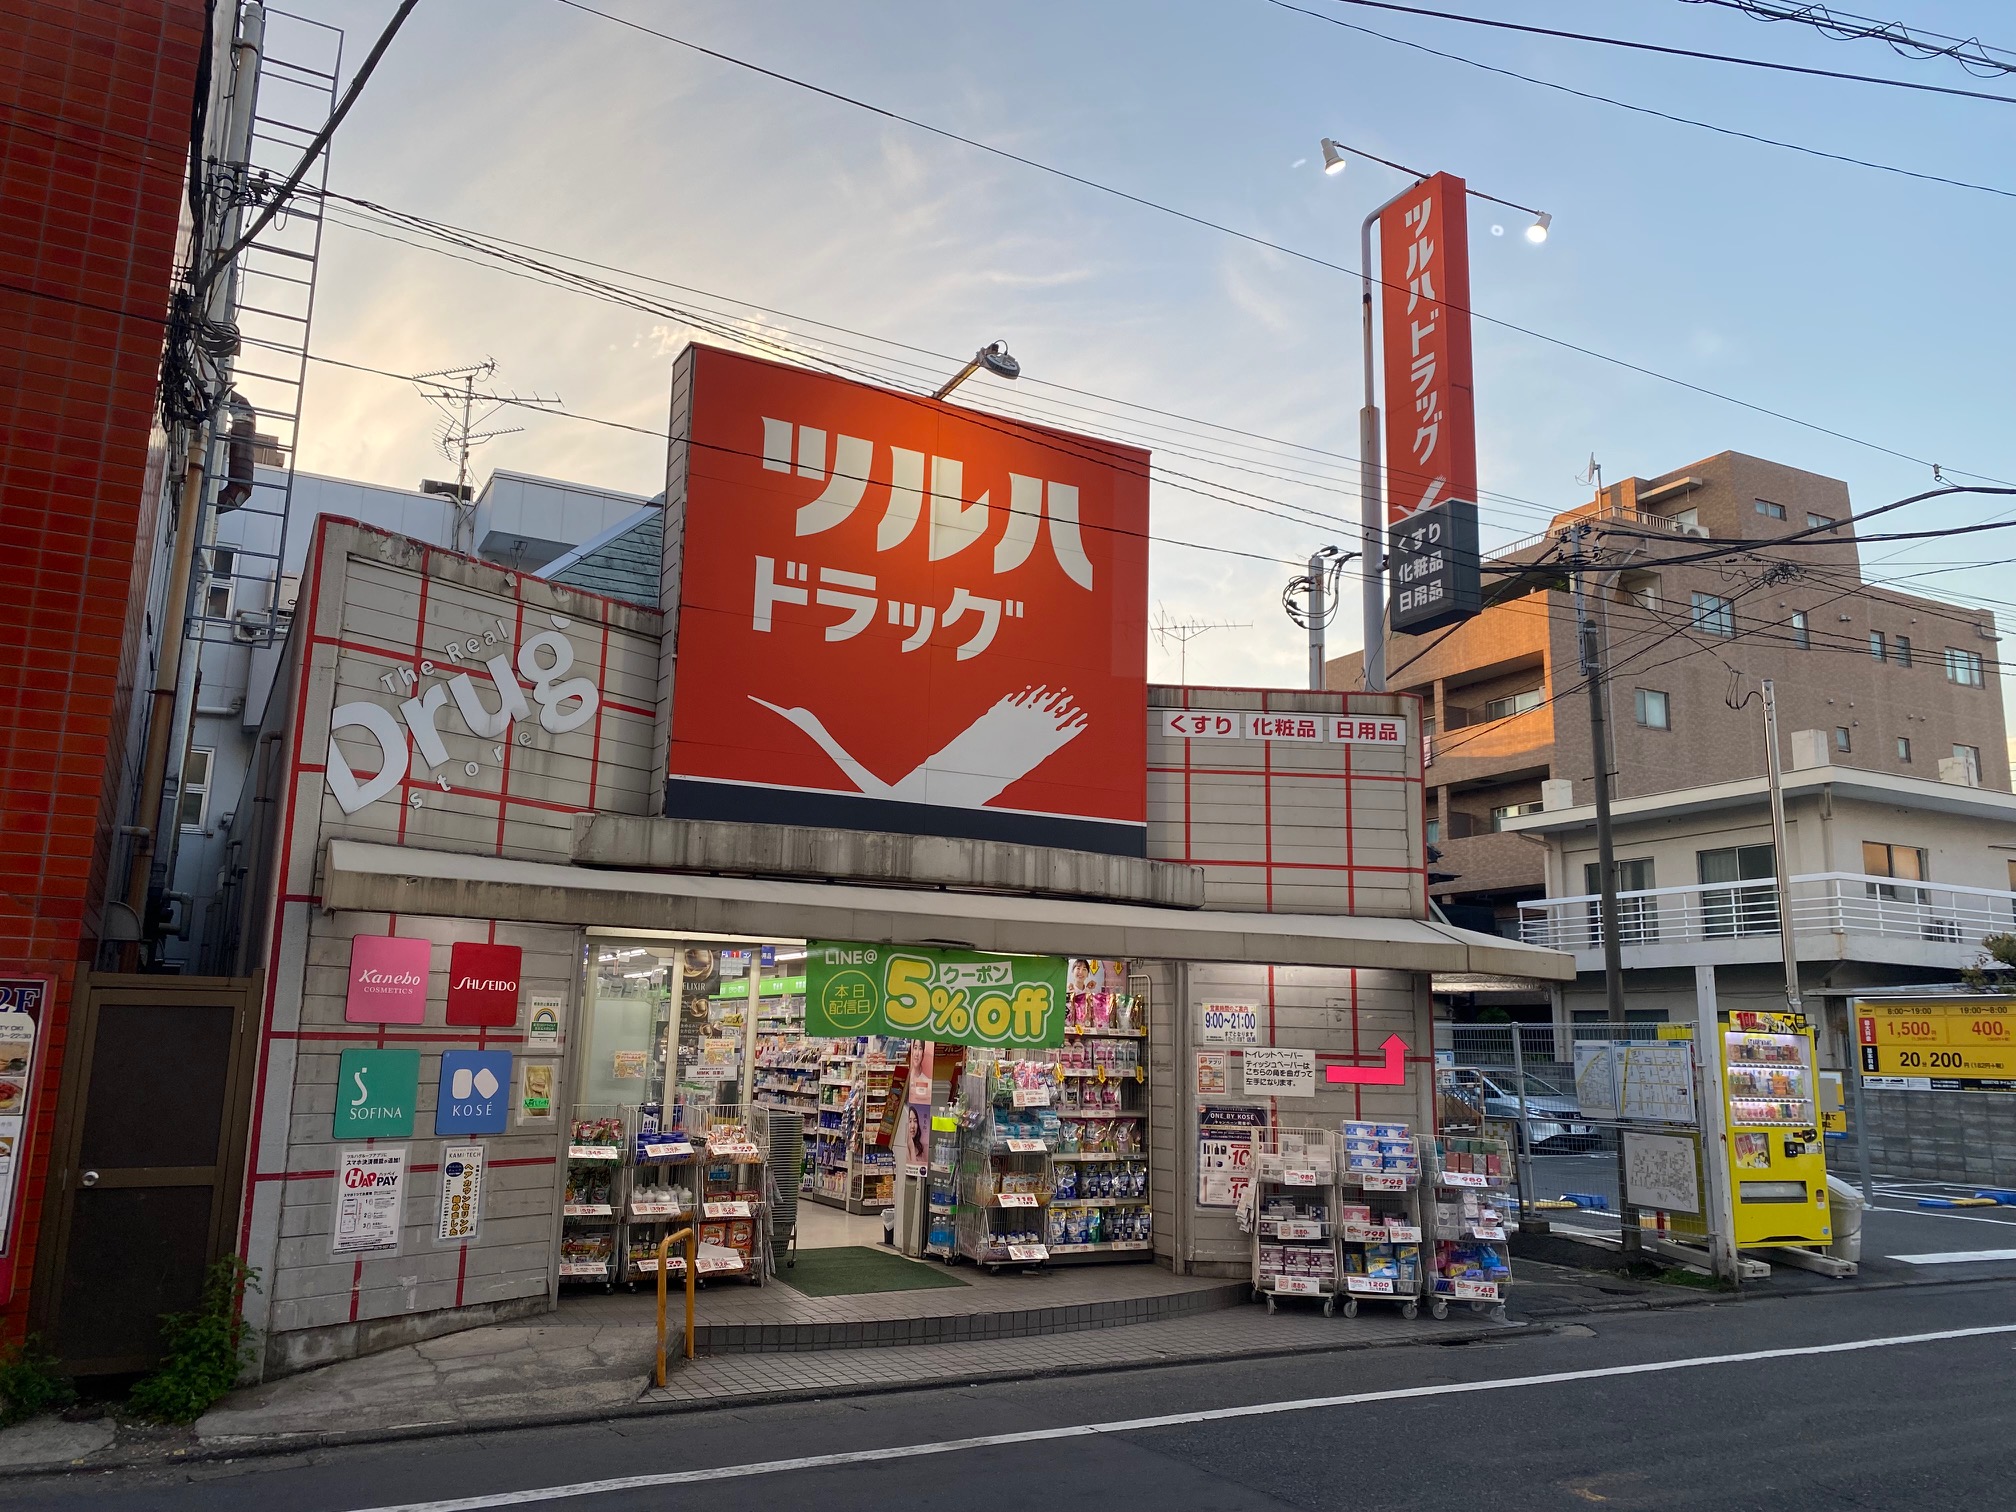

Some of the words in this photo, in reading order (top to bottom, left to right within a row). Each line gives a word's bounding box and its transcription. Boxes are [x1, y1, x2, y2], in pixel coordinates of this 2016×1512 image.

[1404, 197, 1443, 466] ツルハドラッグ
[761, 416, 1094, 592] ツルハ
[1397, 522, 1441, 554] くすり
[1398, 550, 1444, 584] 化粧品
[1399, 579, 1444, 612] 日用品
[752, 555, 1024, 662] ドラッグ
[379, 660, 435, 694] The
[444, 619, 509, 664] Real
[325, 614, 600, 816] Drug
[1169, 714, 1233, 735] くすり
[1252, 717, 1317, 739] 化粧品
[1336, 721, 1398, 741] 日用品
[825, 949, 878, 966] LINE@
[358, 968, 421, 987] Kanebo
[452, 976, 517, 992] SHISEIDO
[943, 965, 1009, 985] クーポン
[363, 986, 413, 995] COSMETICS
[834, 983, 866, 998] 本日
[828, 999, 871, 1016] 配信日
[1205, 1012, 1256, 1030] 9:00~21:00
[349, 1106, 402, 1120] SOFINA
[452, 1101, 493, 1117] KOSÉ
